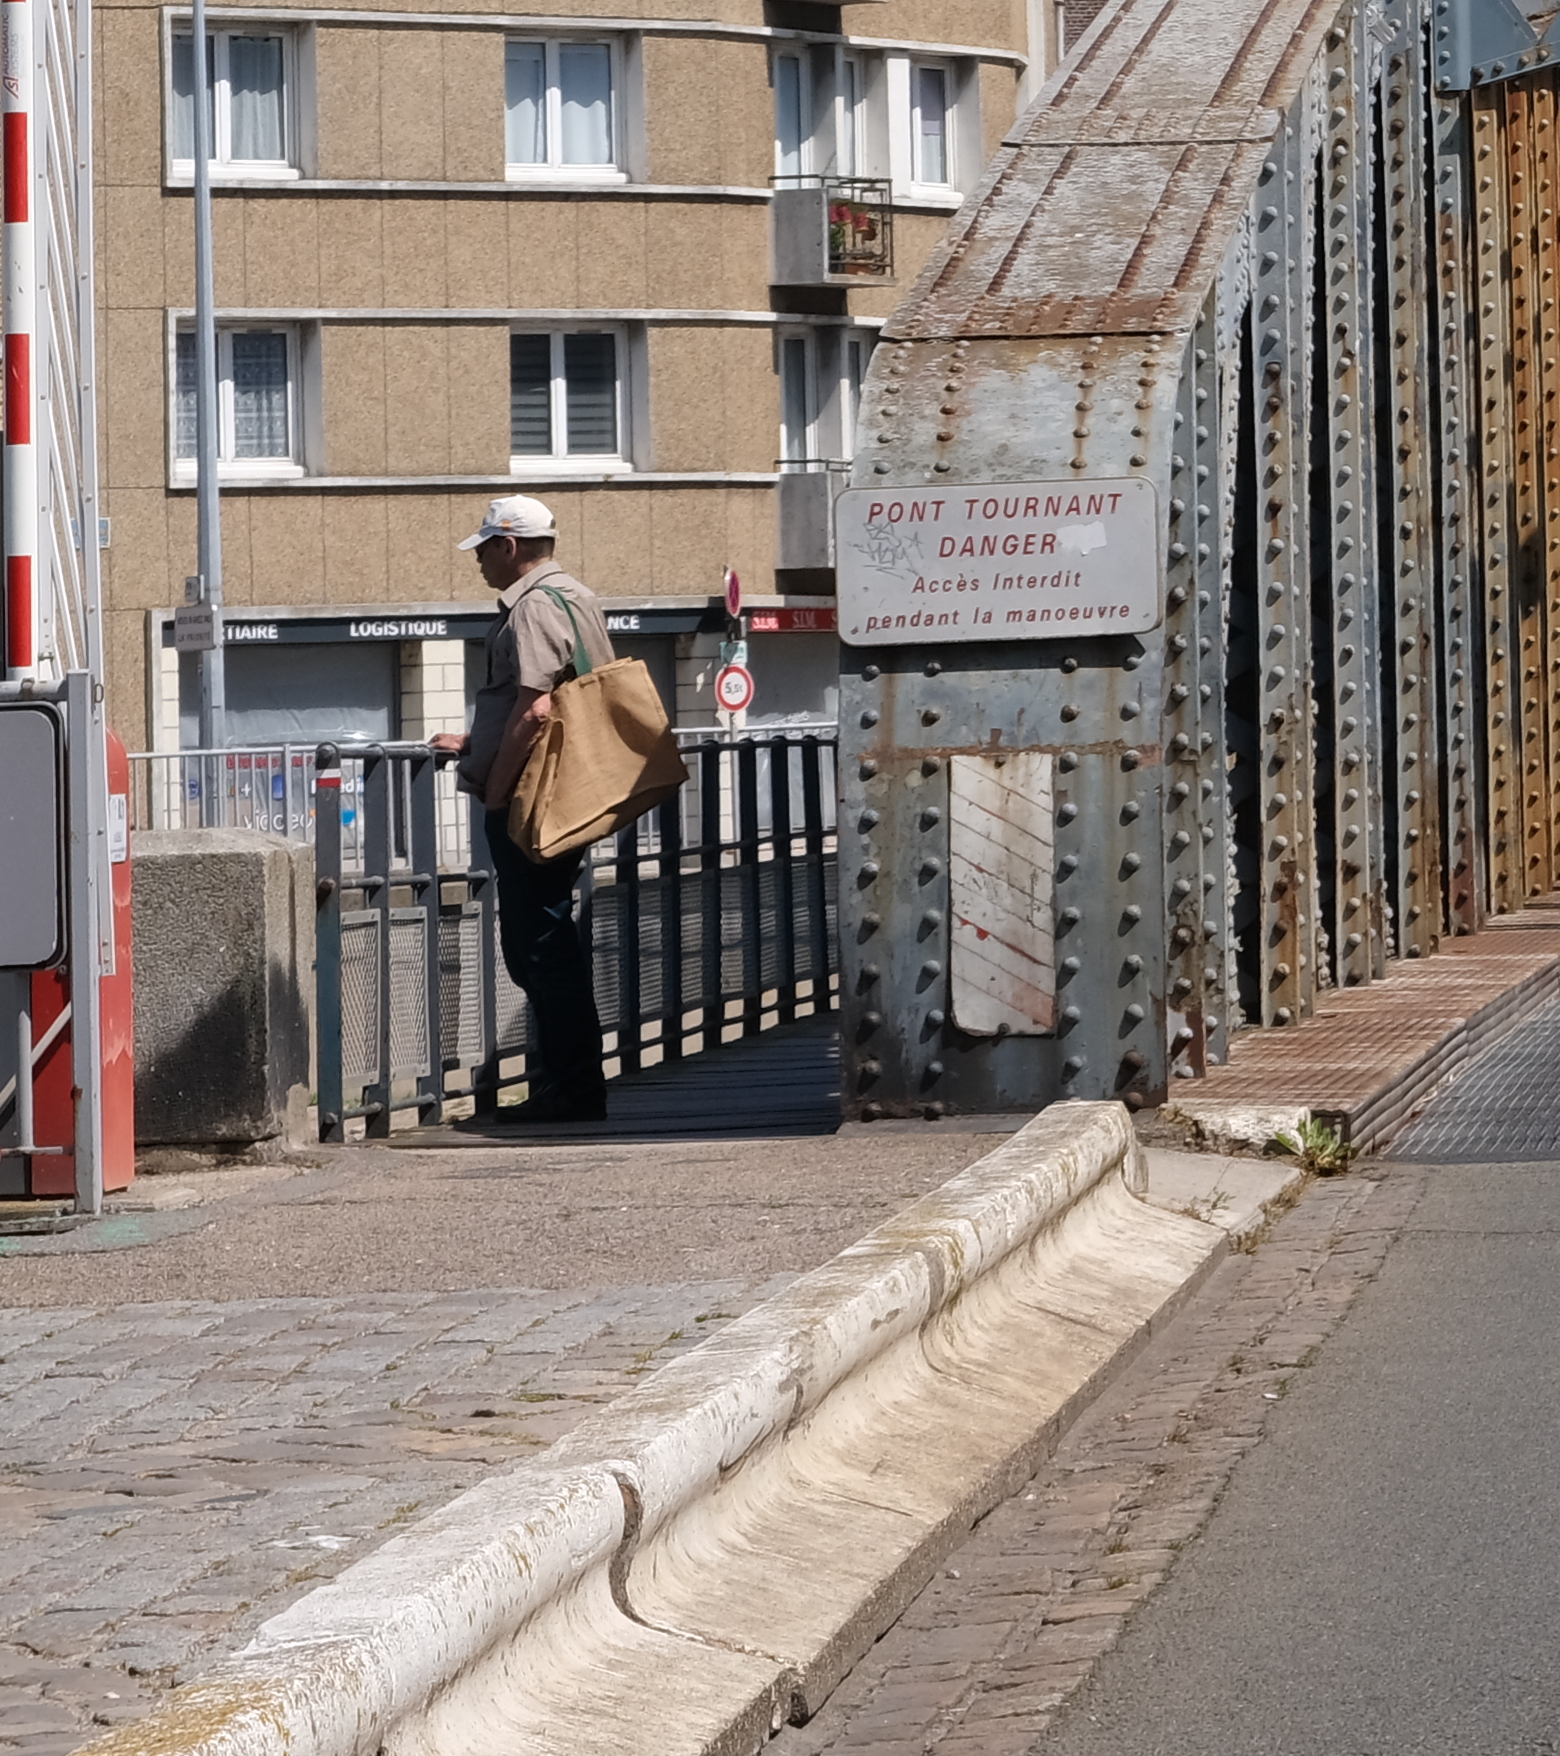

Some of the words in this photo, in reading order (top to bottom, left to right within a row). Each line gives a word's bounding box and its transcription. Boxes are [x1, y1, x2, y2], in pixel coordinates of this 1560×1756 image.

[867, 500, 946, 524] PONT
[963, 493, 1123, 520] TOURNANT
[937, 533, 1059, 558] DANGER
[911, 572, 980, 594] Accès
[992, 570, 1082, 591] Interdit
[349, 619, 448, 637] LOGISTIQUE
[864, 608, 961, 634] pendant
[972, 606, 993, 625] la
[1005, 603, 1131, 624] manoeuvre
